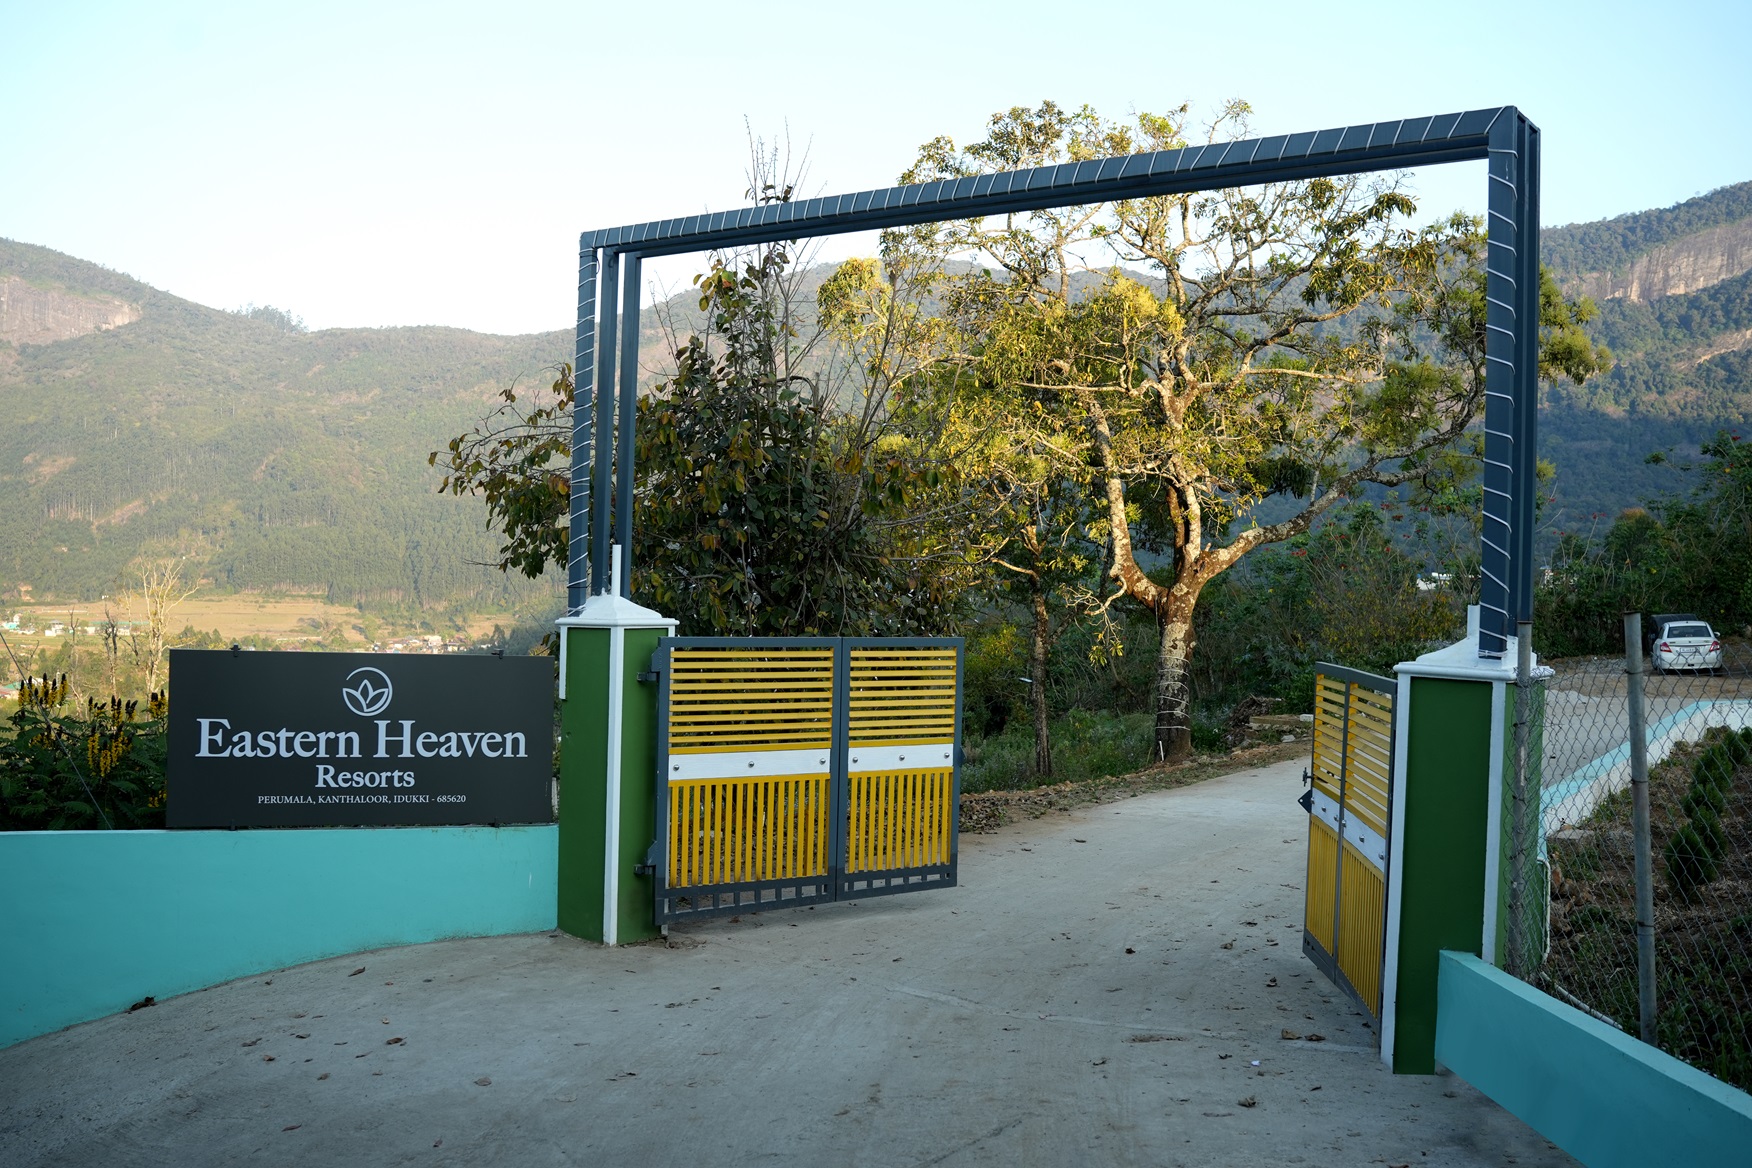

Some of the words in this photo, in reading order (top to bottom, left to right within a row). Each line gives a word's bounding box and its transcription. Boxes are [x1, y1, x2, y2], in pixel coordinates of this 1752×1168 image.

[195, 718, 362, 758] Eastern
[373, 719, 528, 758] Heaven
[314, 764, 415, 788] Resorts
[257, 795, 316, 804] PERUMALA,
[317, 795, 392, 804] KANTHALOOR,
[393, 795, 430, 803] IDUKKI
[436, 794, 466, 803] 685620
